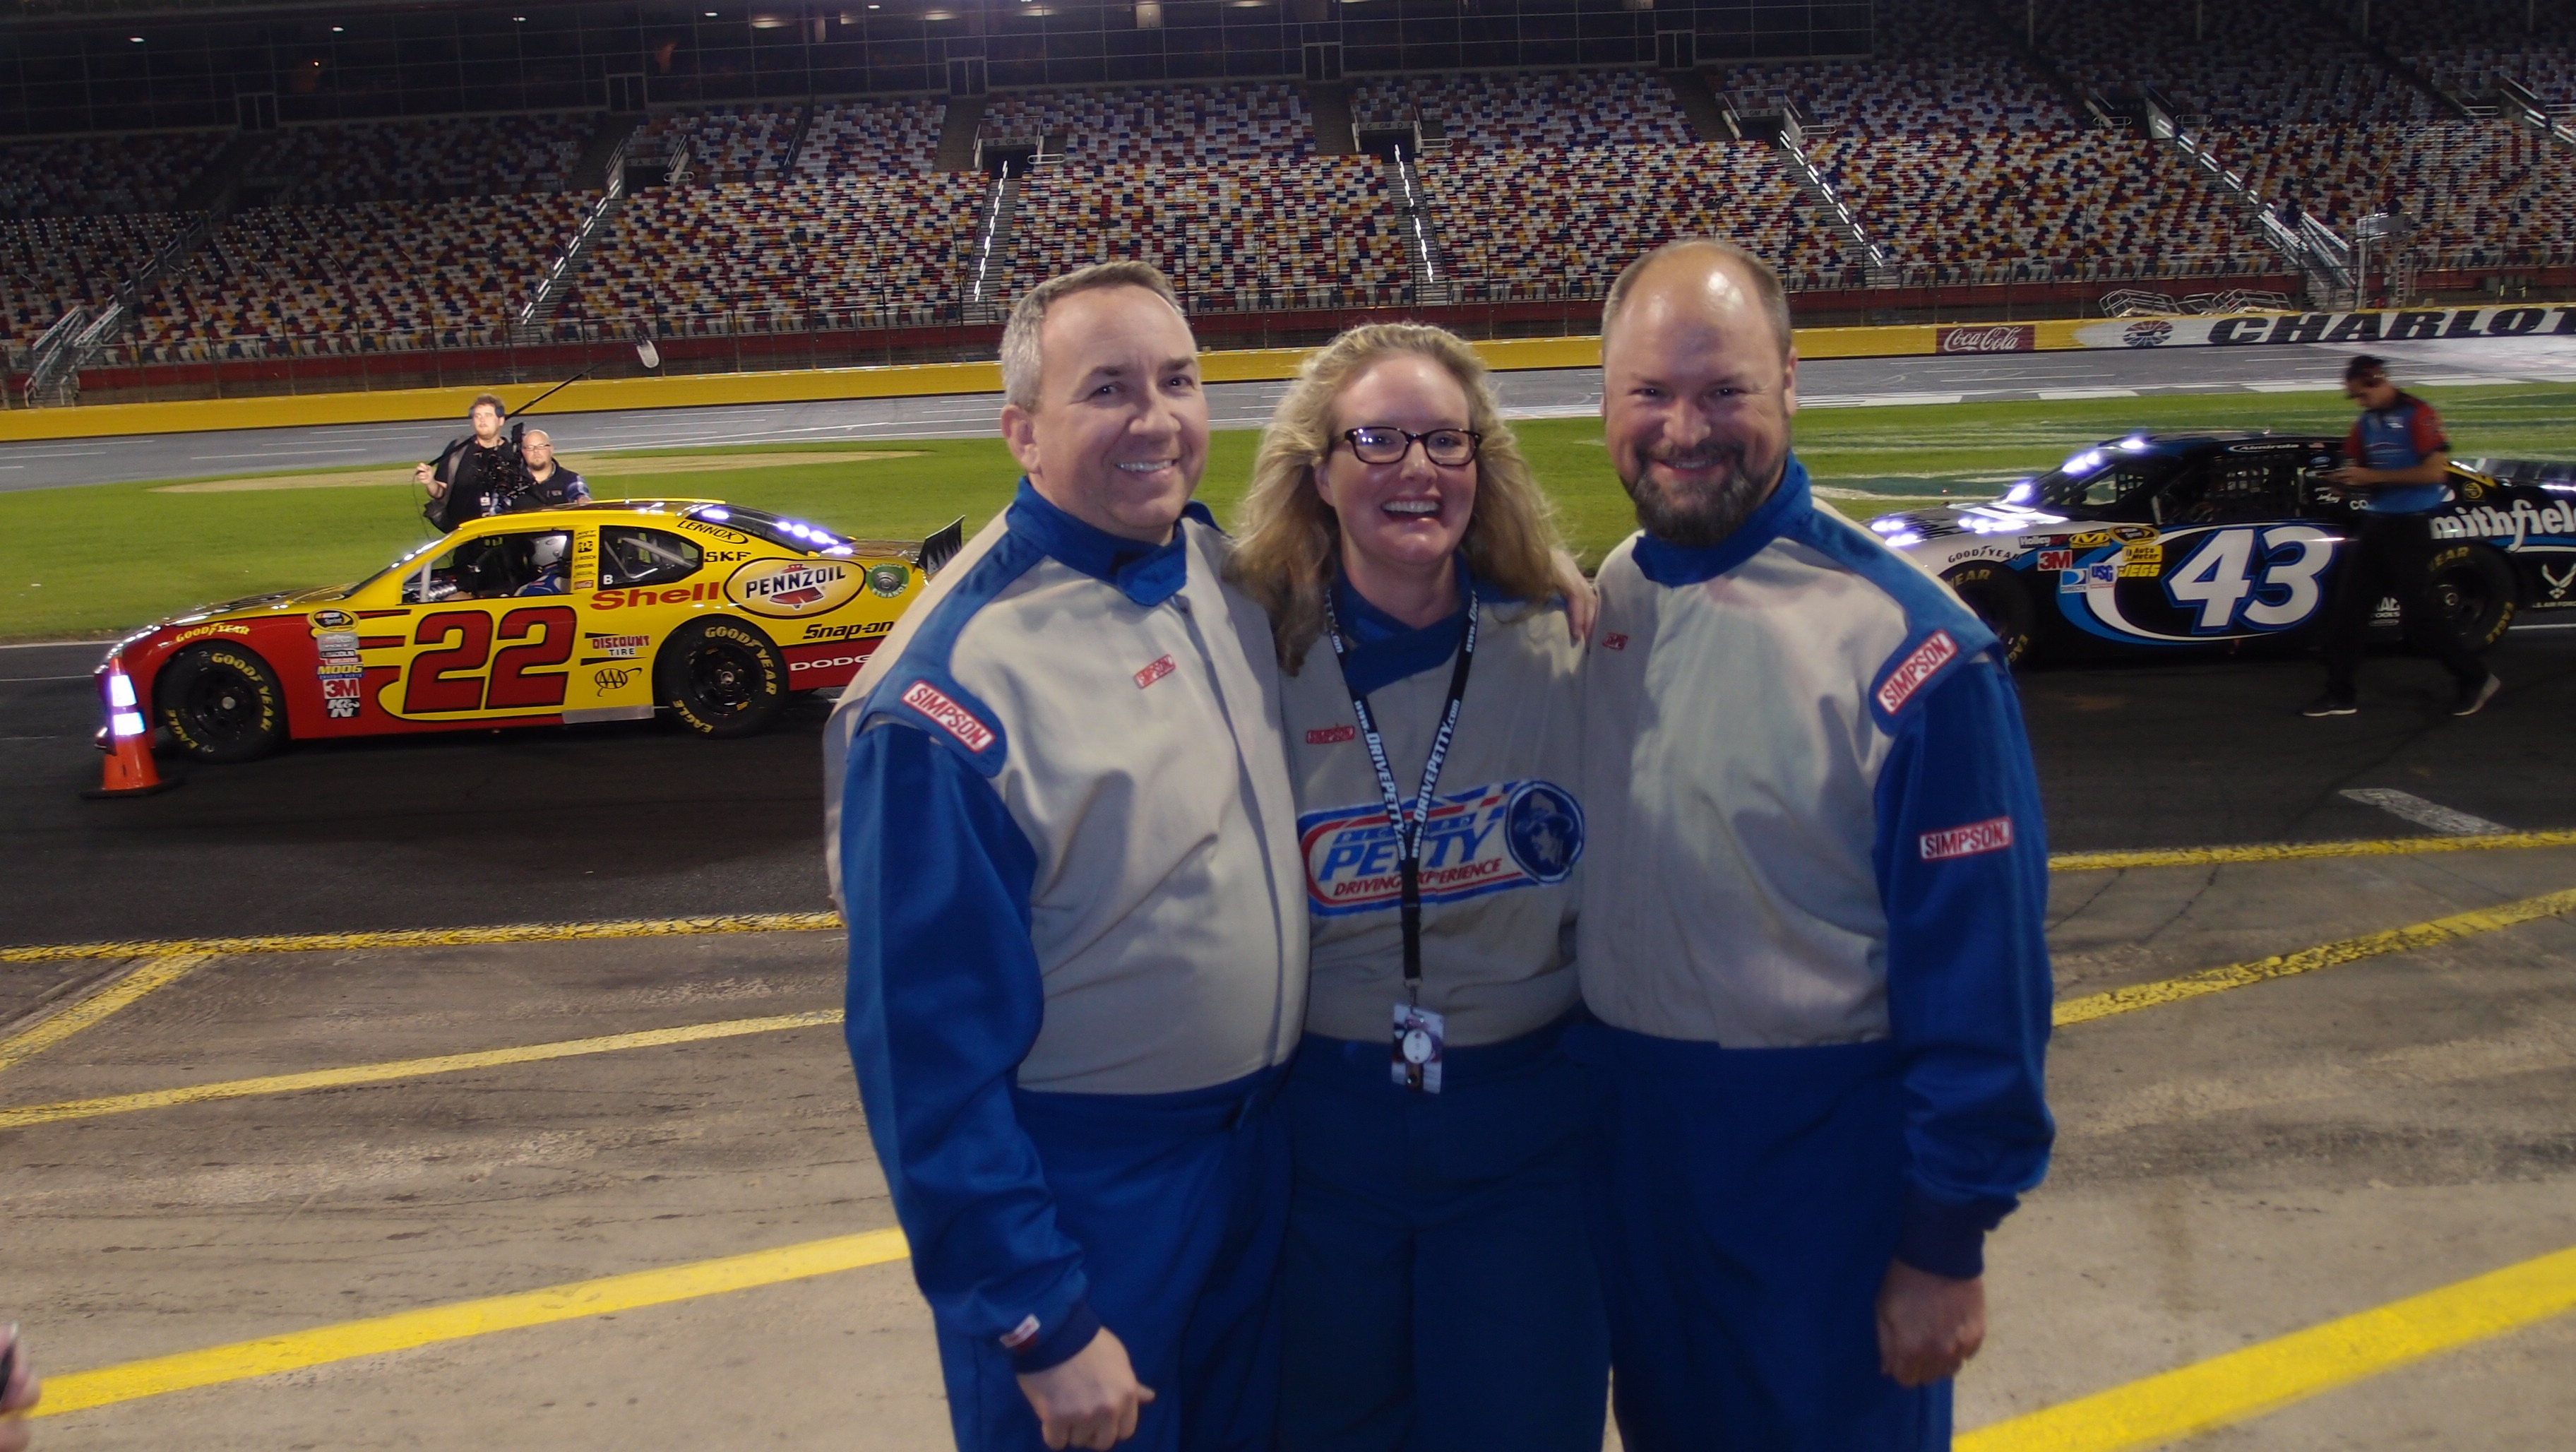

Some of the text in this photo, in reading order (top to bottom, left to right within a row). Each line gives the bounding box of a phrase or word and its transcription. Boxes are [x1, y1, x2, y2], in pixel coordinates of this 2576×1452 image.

[1943, 326, 2025, 352] Coca-Cola
[676, 520, 737, 541] LENNOX
[2429, 499, 2576, 553] mithfiel
[704, 551, 752, 563] SKF
[2039, 552, 2071, 570] 3M
[603, 574, 614, 585] B
[746, 566, 846, 599] PENNZOIL
[2091, 565, 2113, 582] USG
[2165, 524, 2334, 630] 43
[590, 582, 720, 610] Shell
[871, 583, 907, 598] ETHANOL
[592, 636, 650, 649] DISCOUNT
[802, 621, 895, 640] Snap-on
[402, 605, 577, 715] 22
[609, 648, 636, 656] TIRE
[705, 626, 777, 696] GOODYEAR
[318, 665, 363, 674] MOOG
[597, 668, 627, 689] AAA
[1883, 636, 1949, 707] SIMPSON
[326, 679, 358, 698] 3M
[672, 699, 714, 734] EAGLE
[910, 688, 987, 745] SIMPSON
[1318, 822, 1496, 882] PETY
[1925, 823, 2004, 856] SIMPSON
[1333, 857, 1503, 897] DRIVING XPERIENCE
